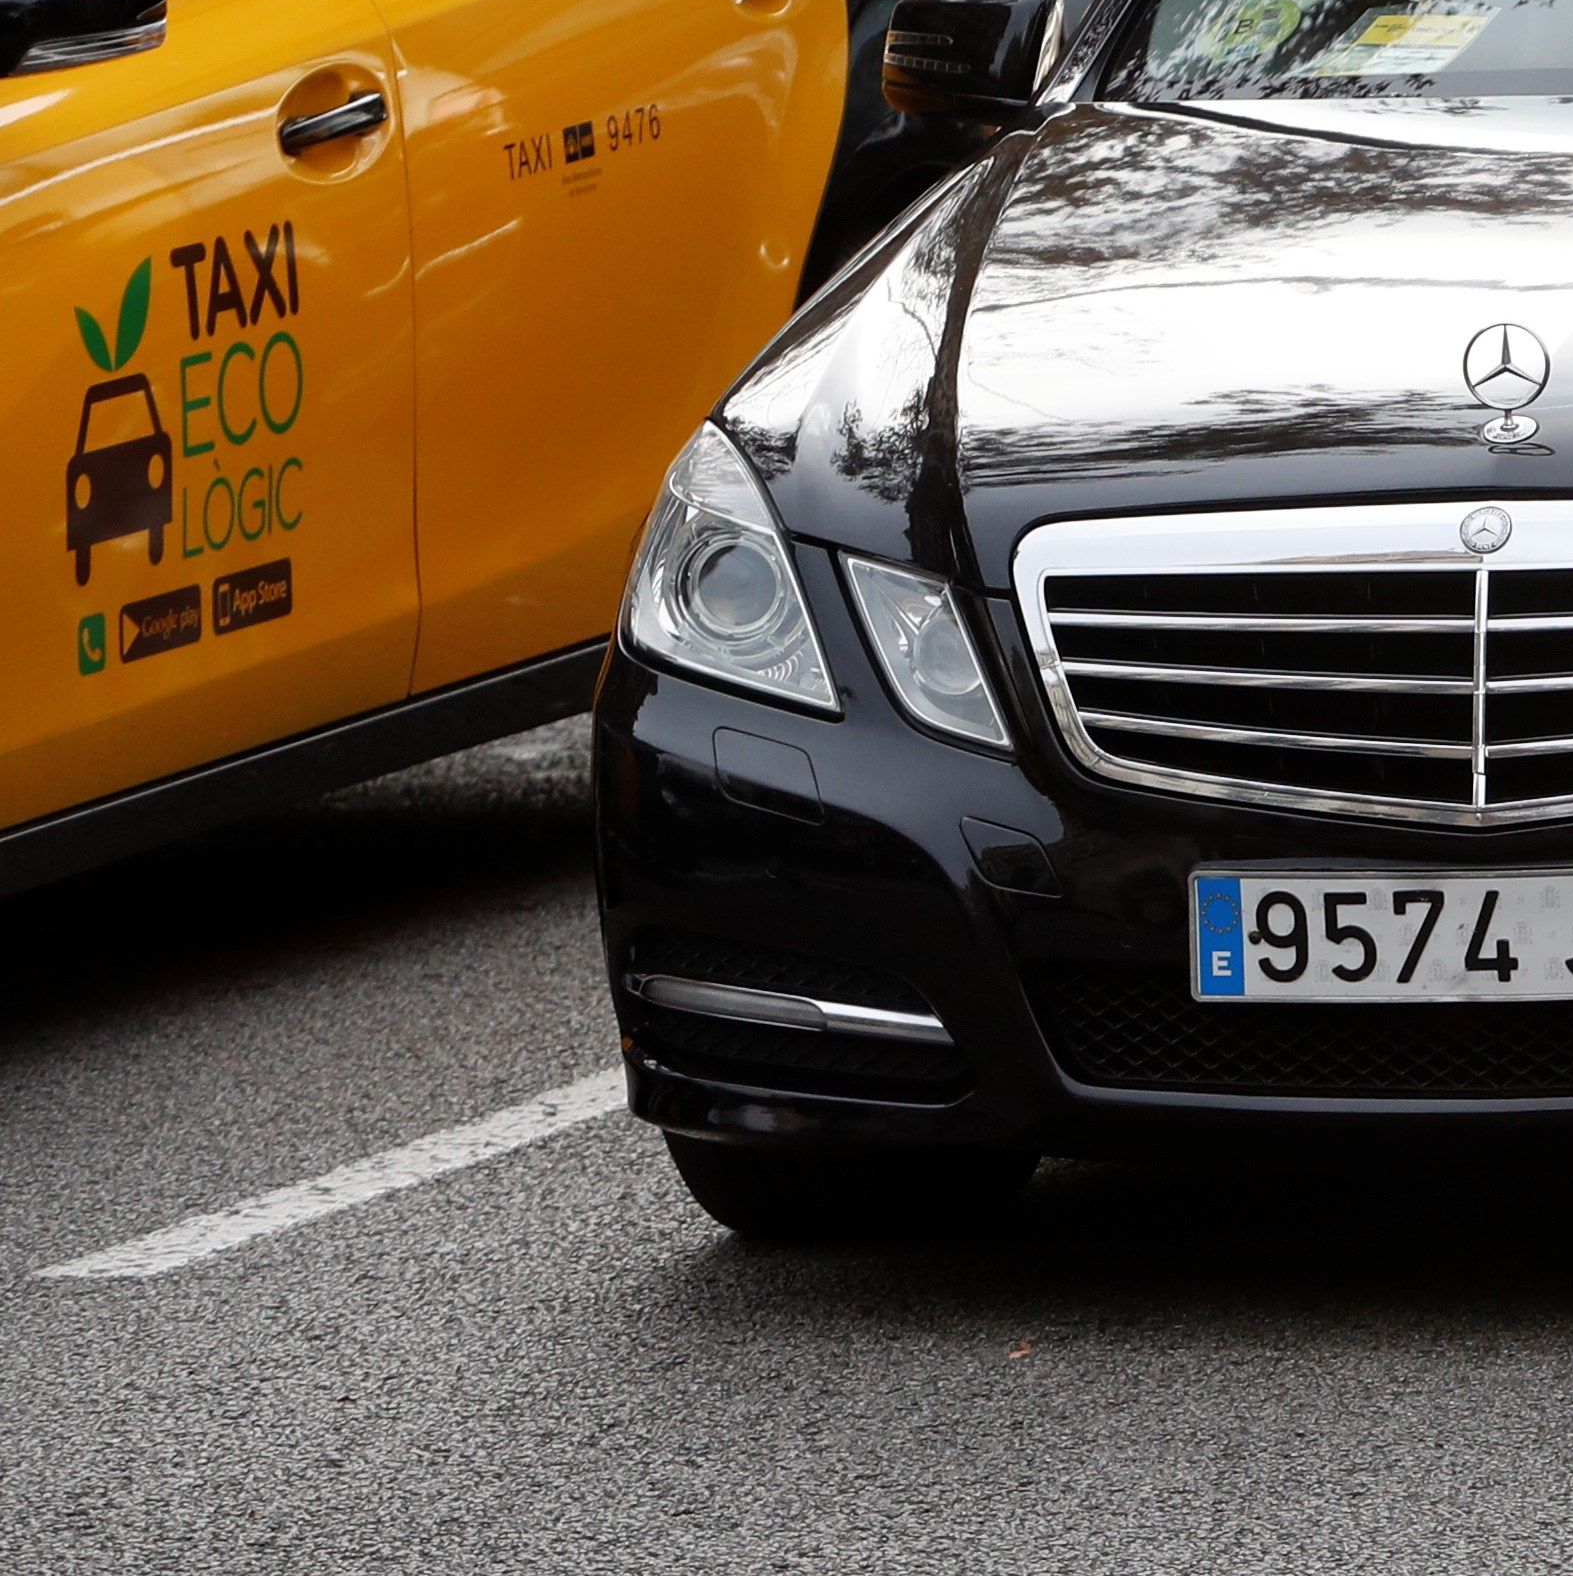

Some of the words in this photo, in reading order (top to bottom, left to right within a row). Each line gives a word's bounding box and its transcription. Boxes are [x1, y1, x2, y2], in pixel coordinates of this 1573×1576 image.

[503, 133, 553, 181] TAXI
[606, 103, 662, 152] 9476
[168, 219, 300, 342] TAXI
[179, 331, 305, 459] ECO
[182, 456, 305, 558] LÒGIC
[232, 586, 258, 615] App
[258, 579, 288, 606] Store
[1212, 951, 1233, 977] E
[1256, 889, 1519, 983] 9574
